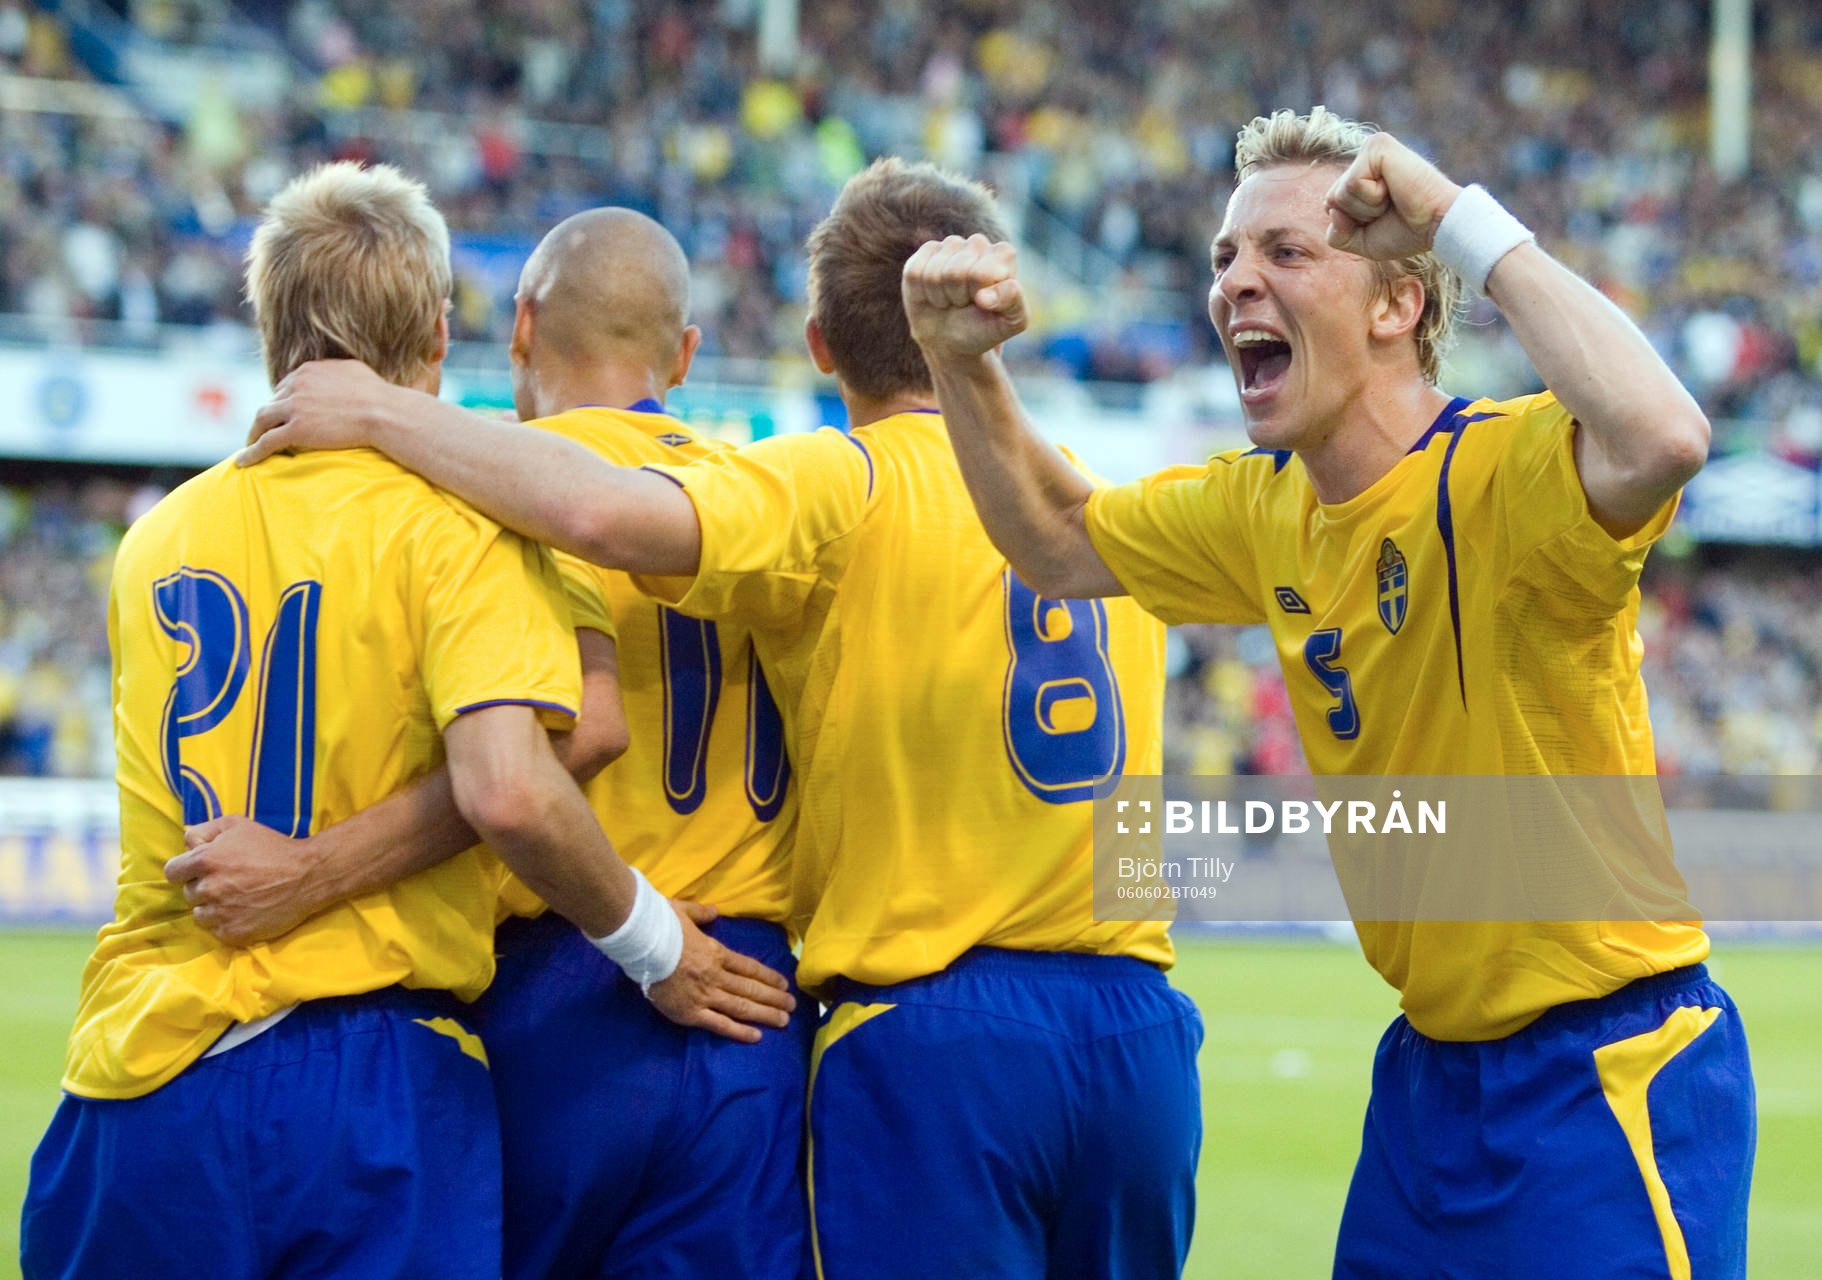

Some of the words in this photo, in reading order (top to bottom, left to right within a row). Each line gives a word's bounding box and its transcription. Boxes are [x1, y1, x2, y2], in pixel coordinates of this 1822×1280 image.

[152, 565, 322, 839] 21
[1002, 563, 1127, 805] 8
[1303, 627, 1360, 740] 5
